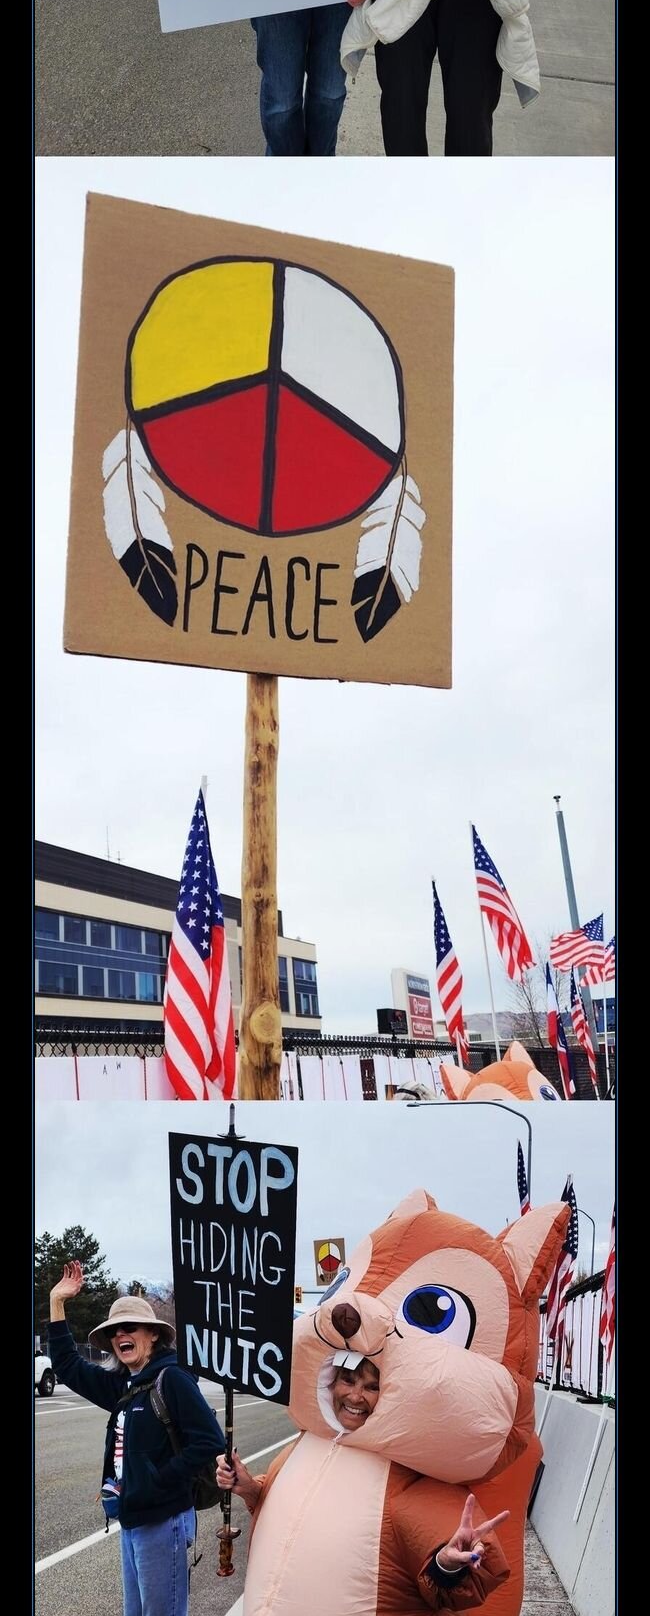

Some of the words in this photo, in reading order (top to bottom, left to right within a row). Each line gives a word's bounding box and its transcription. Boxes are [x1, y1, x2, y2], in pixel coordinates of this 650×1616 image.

[182, 543, 340, 644] PEACE
[176, 1142, 295, 1218] STOP
[178, 1218, 284, 1286] HIDING
[193, 1280, 257, 1333] THE
[184, 1323, 284, 1398] NUTS
